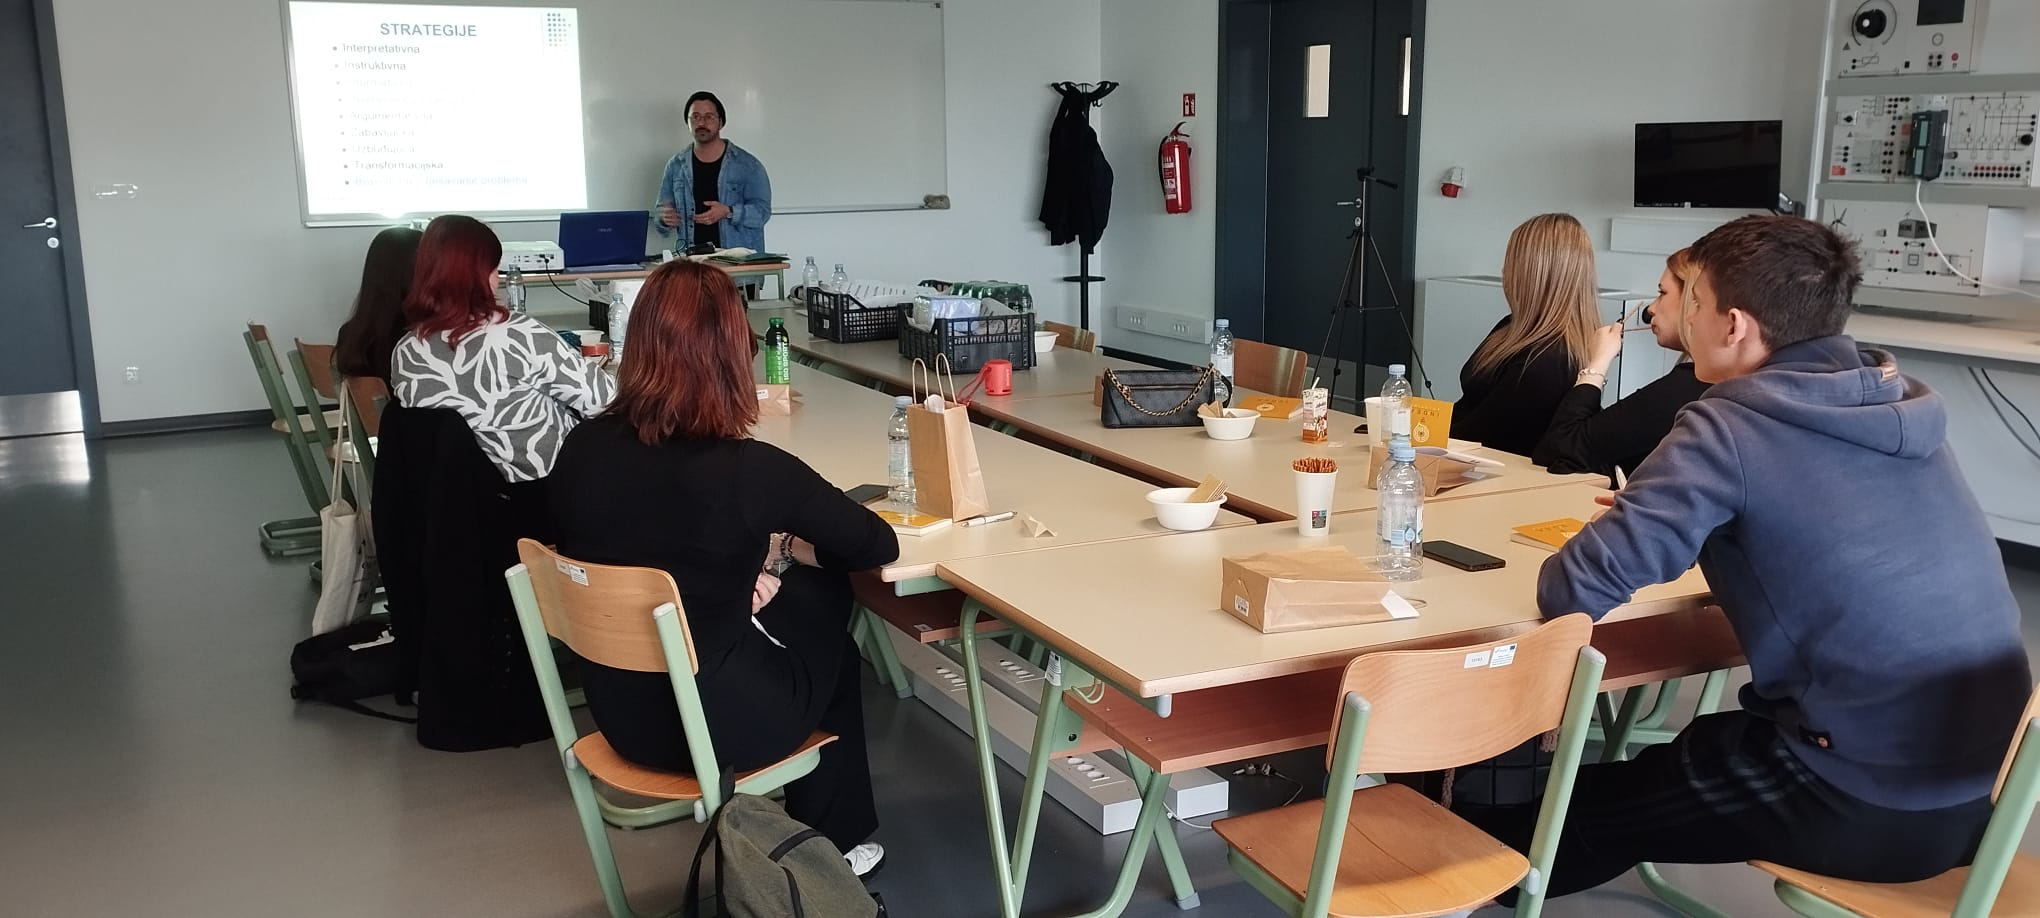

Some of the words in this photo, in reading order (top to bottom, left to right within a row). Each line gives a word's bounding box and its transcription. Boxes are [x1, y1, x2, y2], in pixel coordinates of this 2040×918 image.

[380, 22, 478, 37] STRATEGIJE
[342, 43, 420, 56] Interpretativna
[344, 60, 406, 71] Instruktivna
[350, 111, 433, 123] Argumentatvna
[353, 160, 443, 171] Transformacijska
